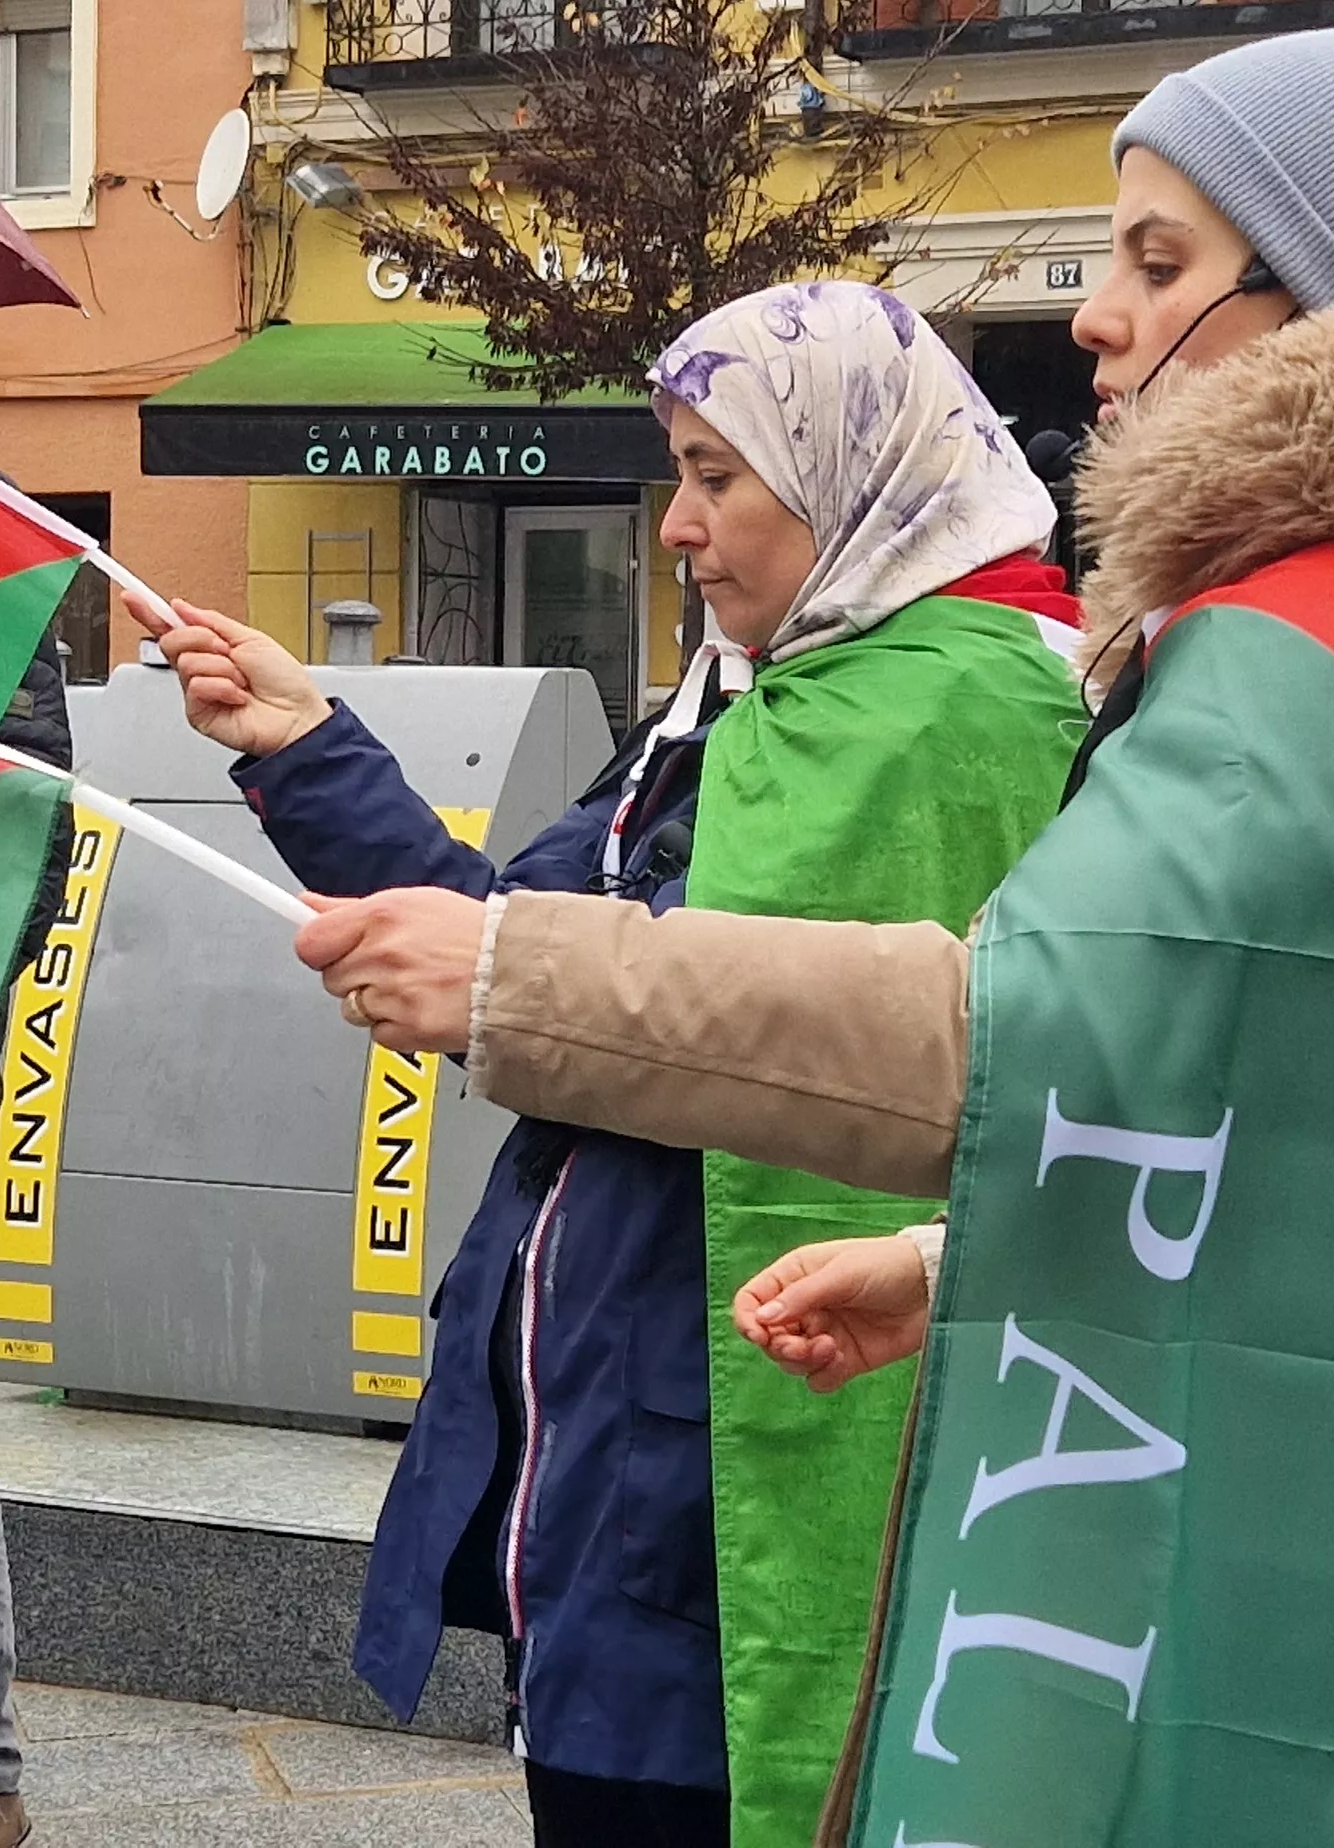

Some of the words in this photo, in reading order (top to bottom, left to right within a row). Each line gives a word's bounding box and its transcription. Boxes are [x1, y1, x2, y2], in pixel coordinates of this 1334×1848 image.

[1051, 263, 1078, 286] 87
[308, 425, 545, 440] CAFETERIA
[306, 446, 547, 475] GARABATO
[5, 830, 102, 1225] ENVASES
[892, 1087, 1234, 1848] PAL
